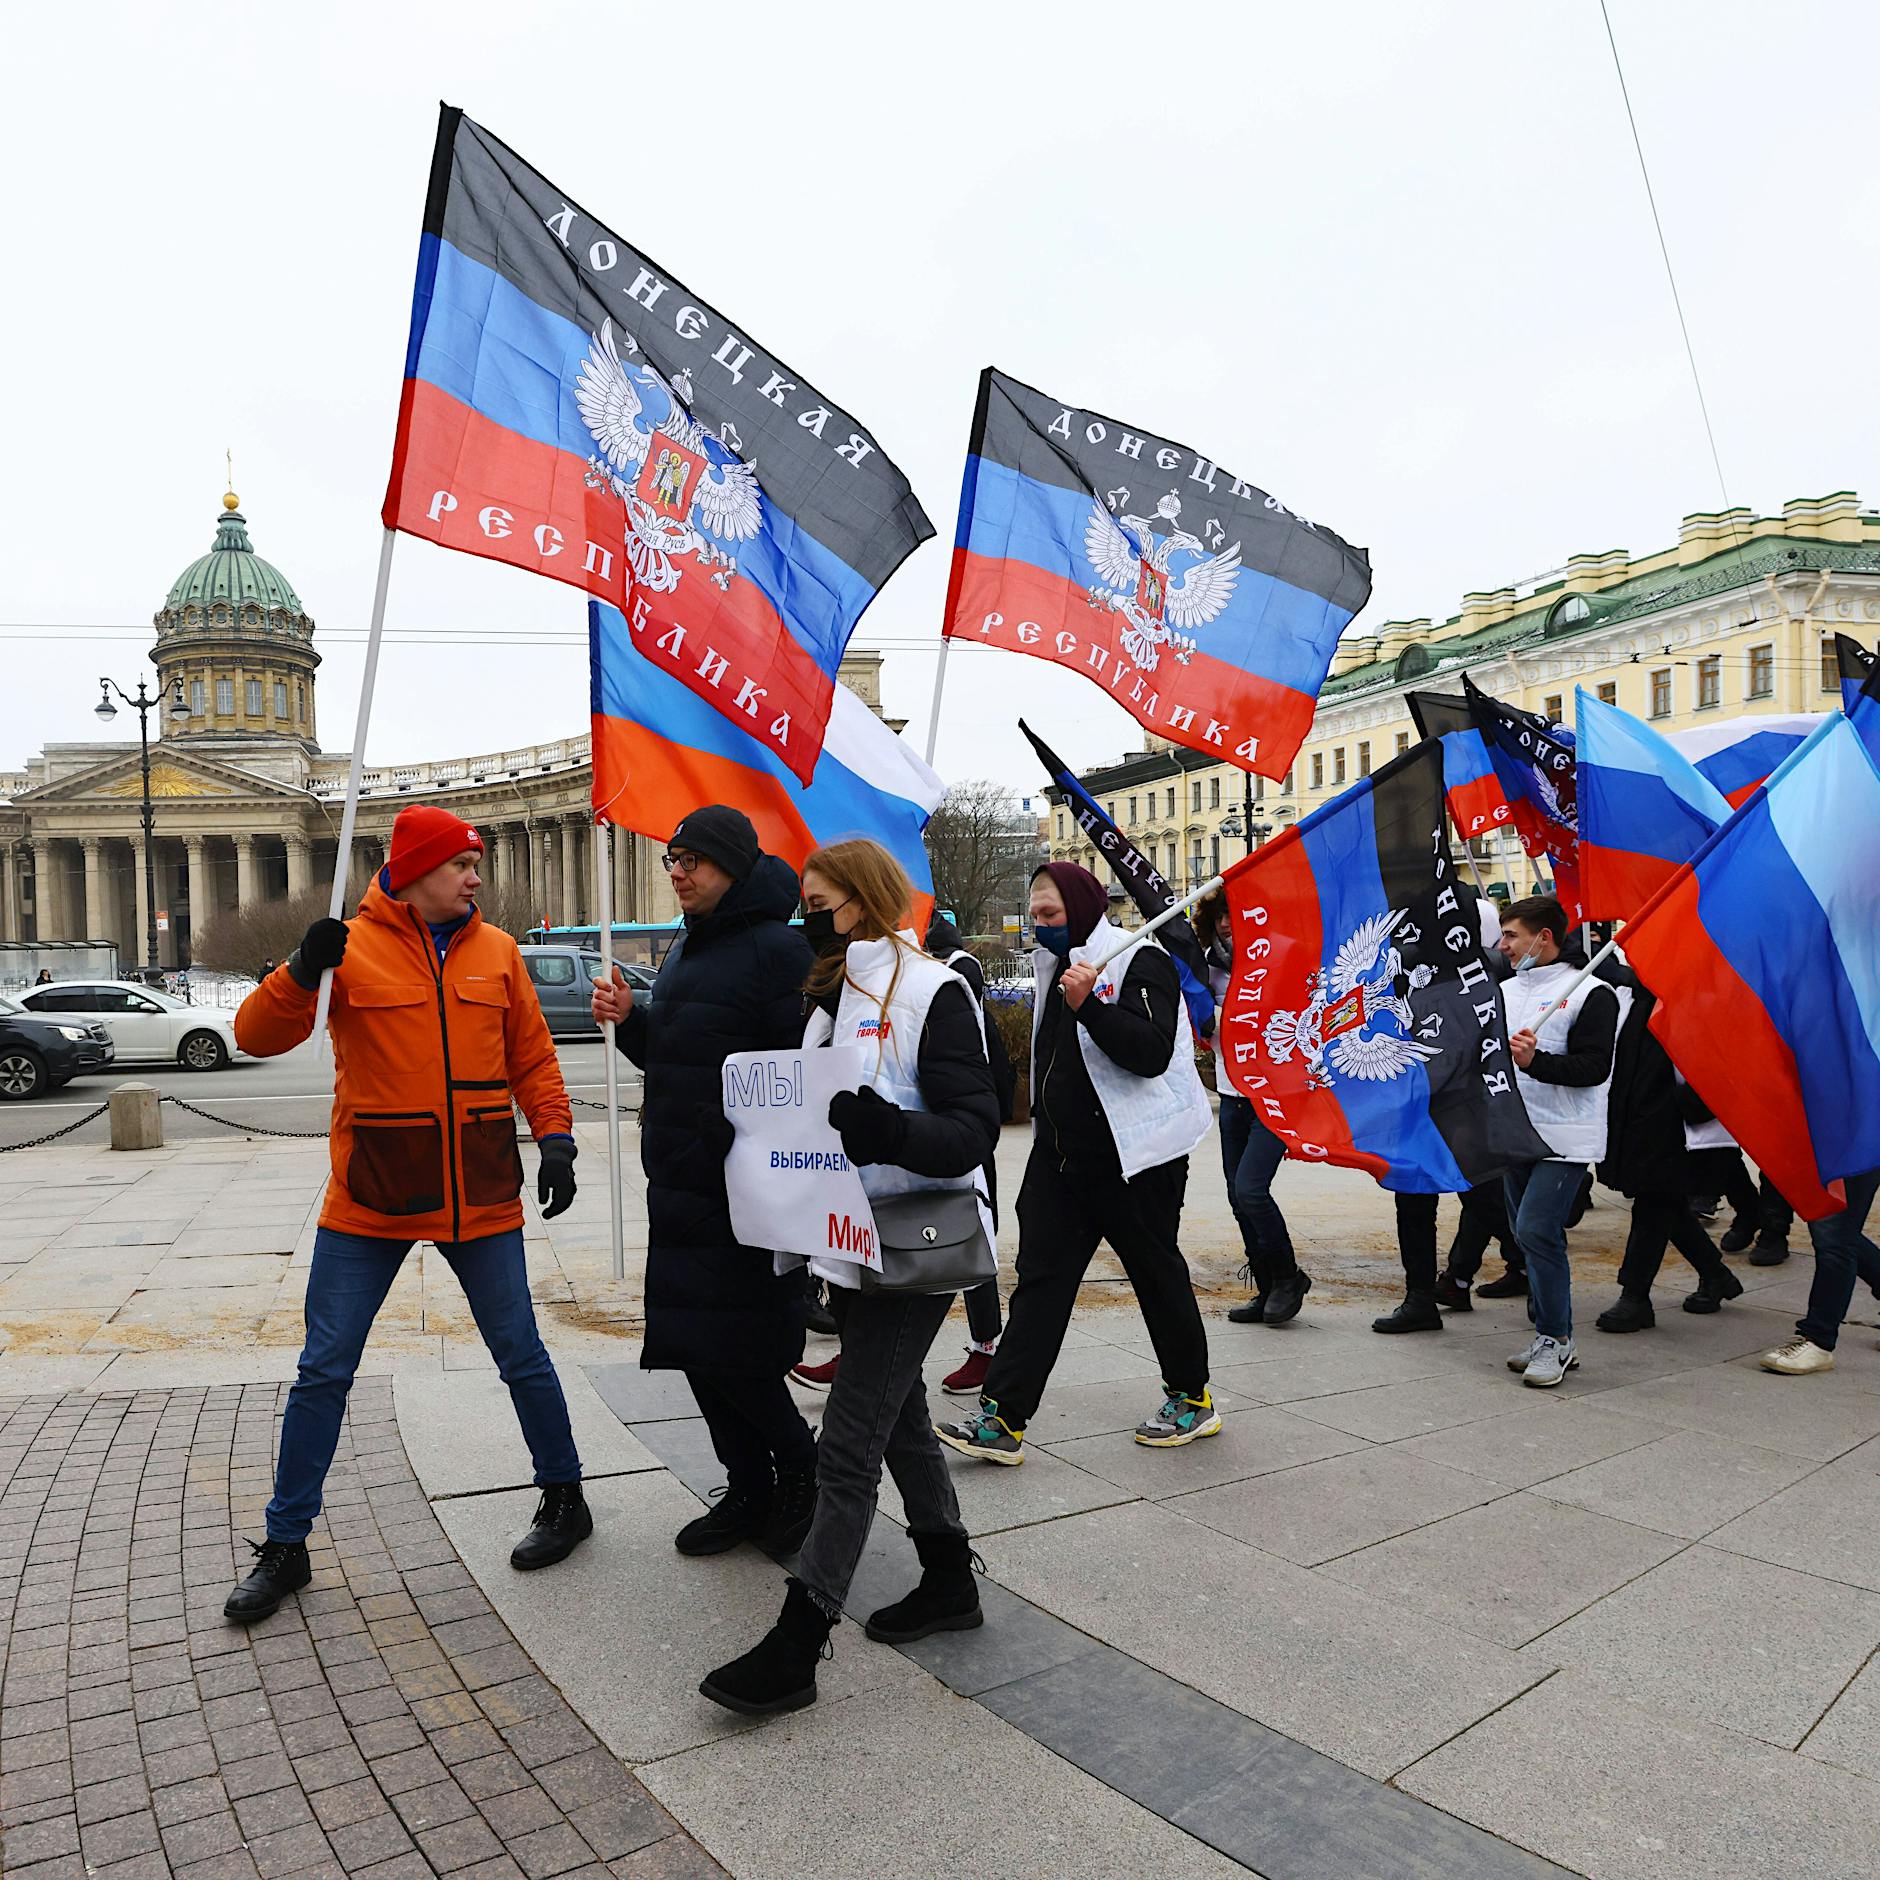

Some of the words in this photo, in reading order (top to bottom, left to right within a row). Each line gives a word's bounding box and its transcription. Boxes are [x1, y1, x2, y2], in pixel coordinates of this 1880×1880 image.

[979, 611, 1261, 763] РЕСПУБЛИКА
[725, 1060, 803, 1108] МЫ
[770, 1151, 850, 1172] ВЫБИРАЕМ
[828, 1213, 876, 1264] Мир!
